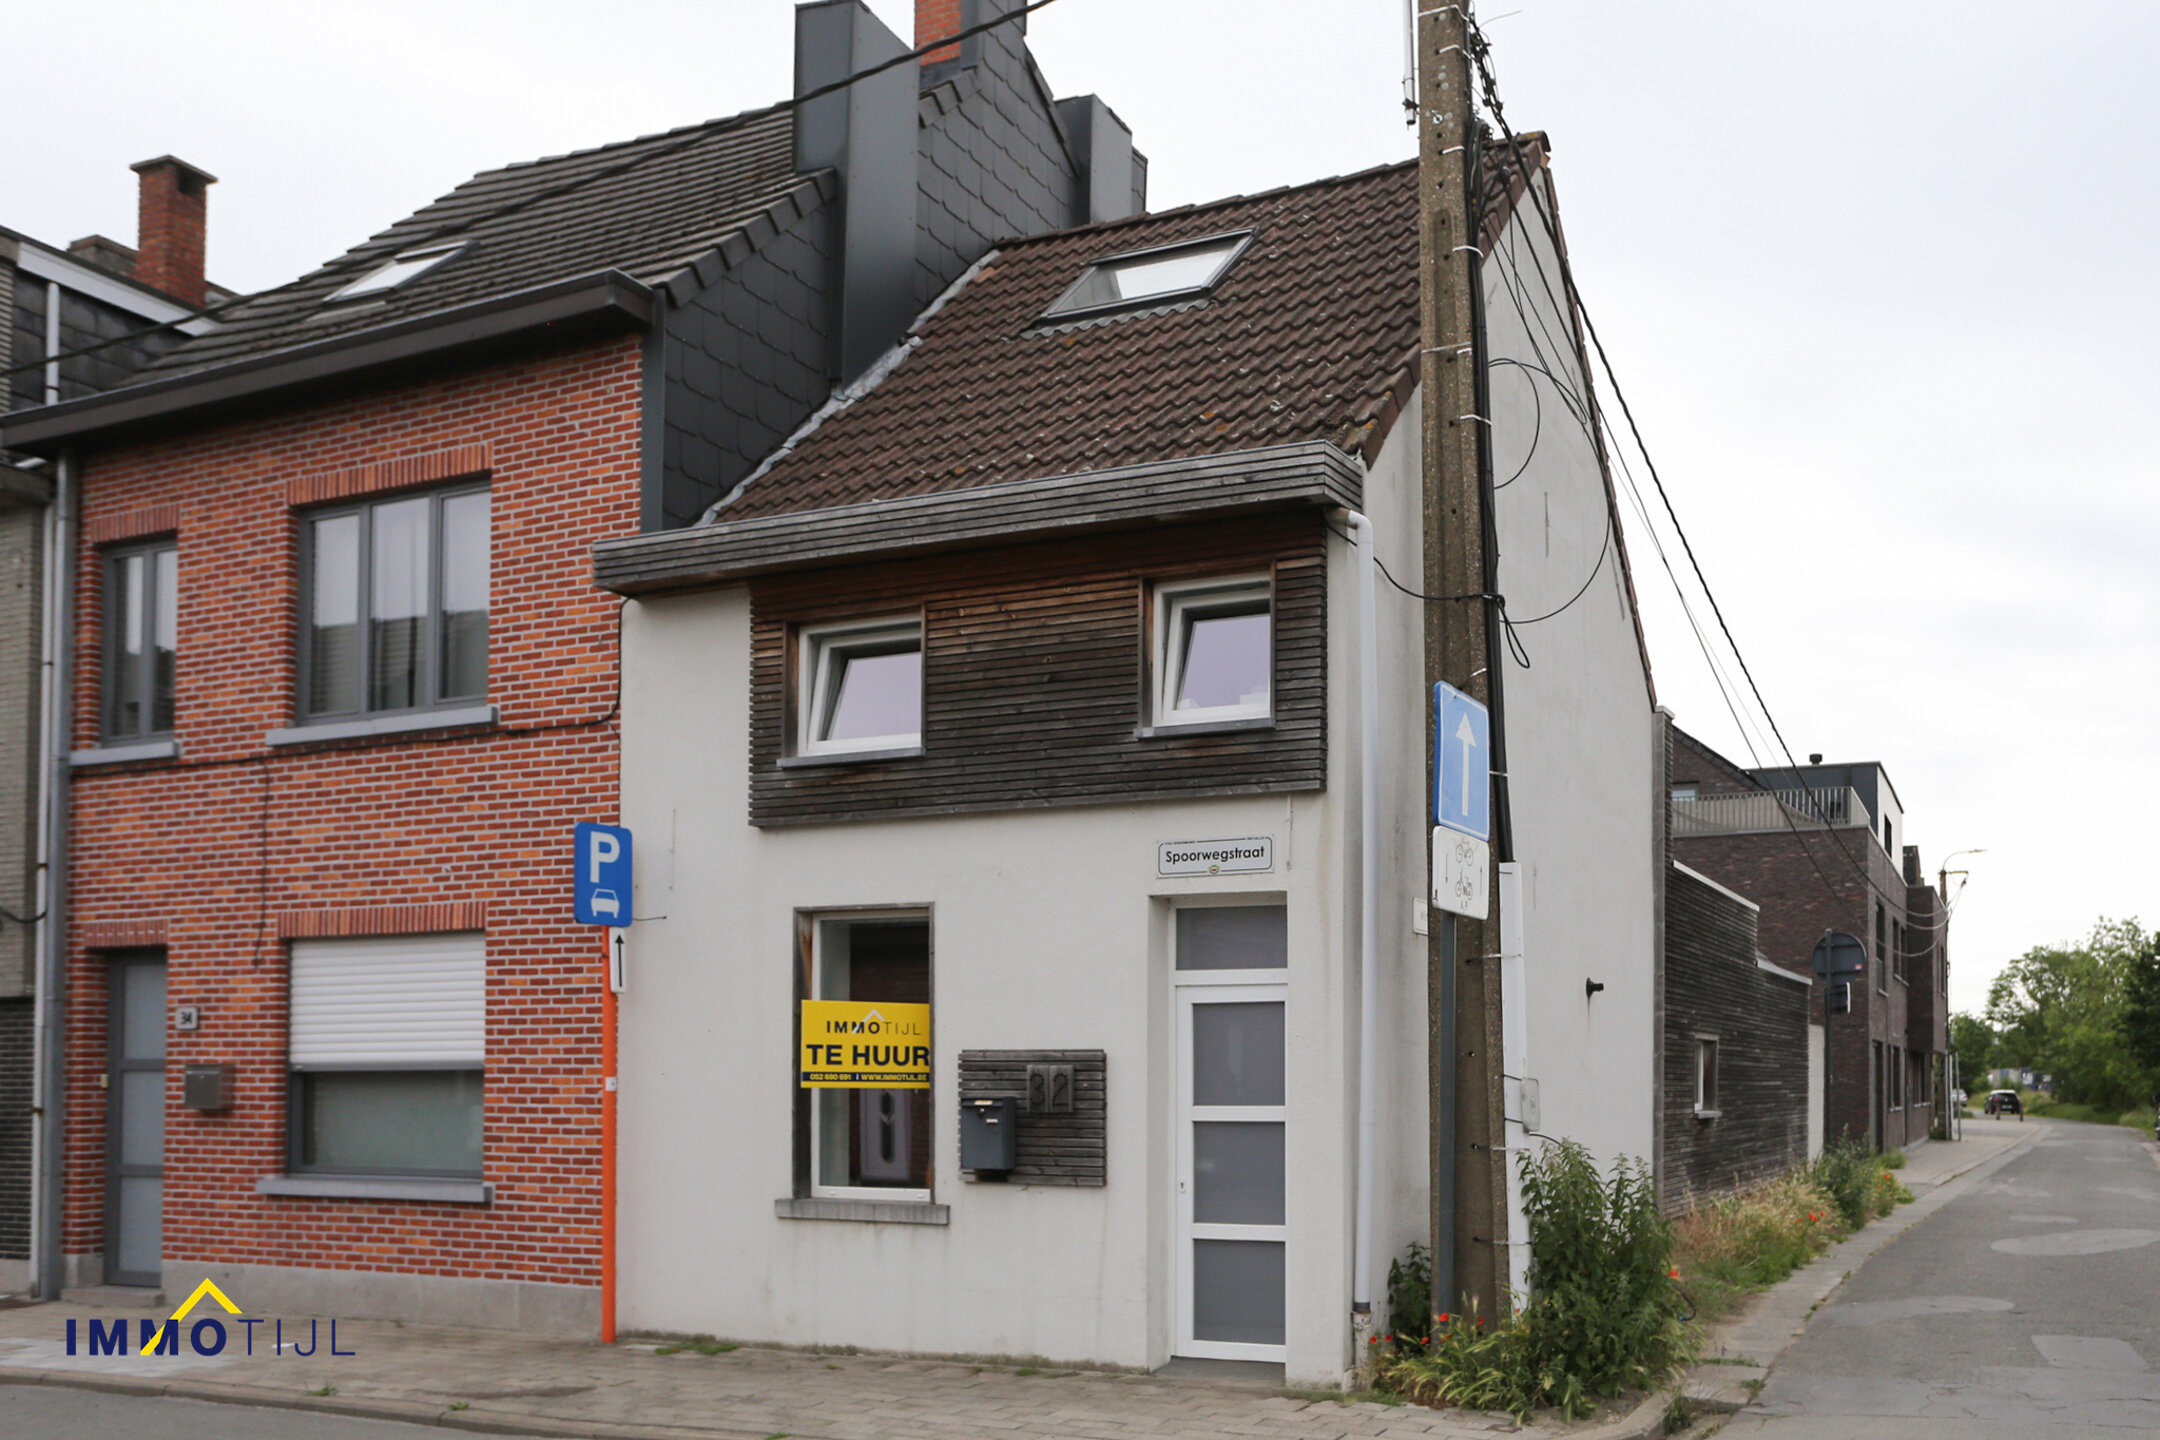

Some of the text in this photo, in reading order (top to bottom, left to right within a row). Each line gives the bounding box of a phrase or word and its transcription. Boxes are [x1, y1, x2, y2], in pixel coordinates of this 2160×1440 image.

[590, 831, 620, 884] P
[1165, 846, 1265, 865] Spoorwegstraat
[826, 1020, 922, 1036] IMMOTIJL
[806, 1044, 929, 1067] TE HUUR
[1029, 1072, 1069, 1106] 32
